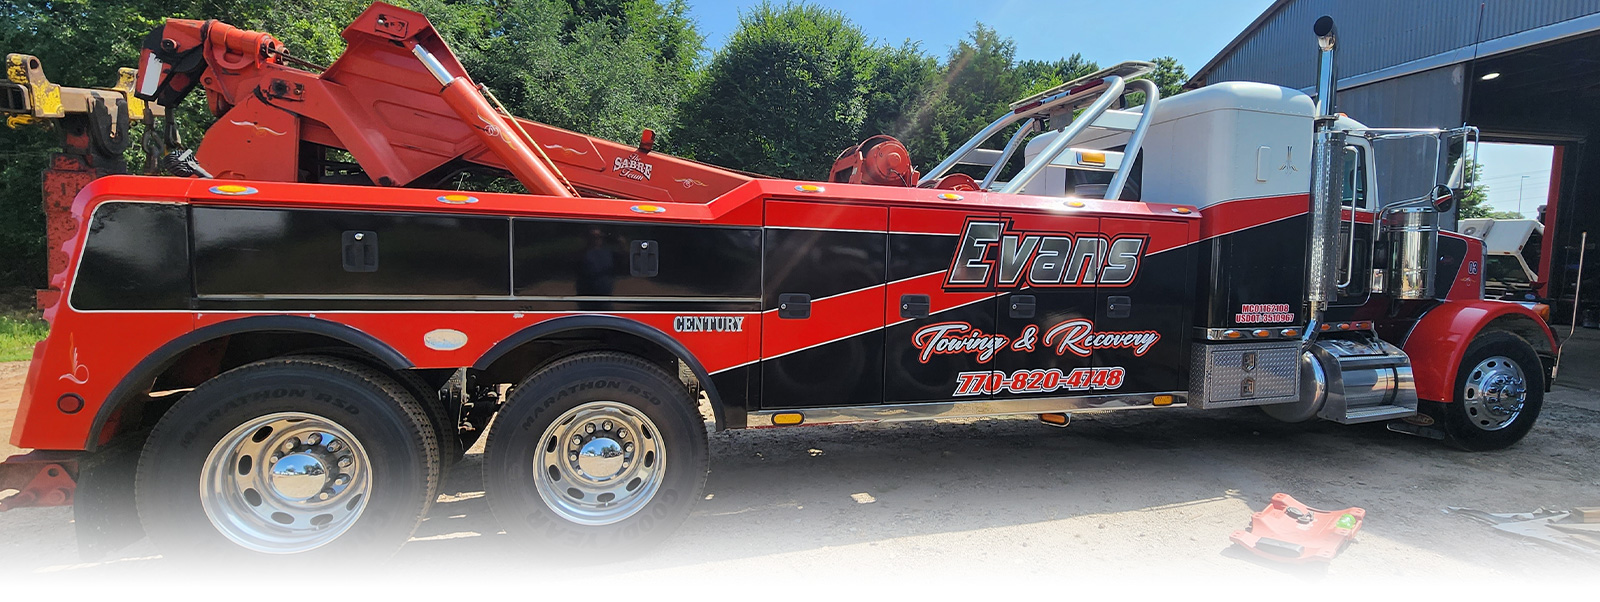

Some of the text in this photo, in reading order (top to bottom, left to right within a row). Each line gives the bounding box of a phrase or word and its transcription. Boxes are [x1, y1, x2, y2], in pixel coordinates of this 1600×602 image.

[613, 156, 653, 181] SABRE
[942, 217, 1150, 292] Evans
[1468, 261, 1478, 275] 03
[673, 315, 745, 333] CENTURY
[912, 318, 1161, 363] Towing & Recovery
[952, 366, 1126, 397] 770-820-4748
[180, 387, 360, 450] MARATHON RSD
[522, 379, 662, 431] MARATHON RSD
